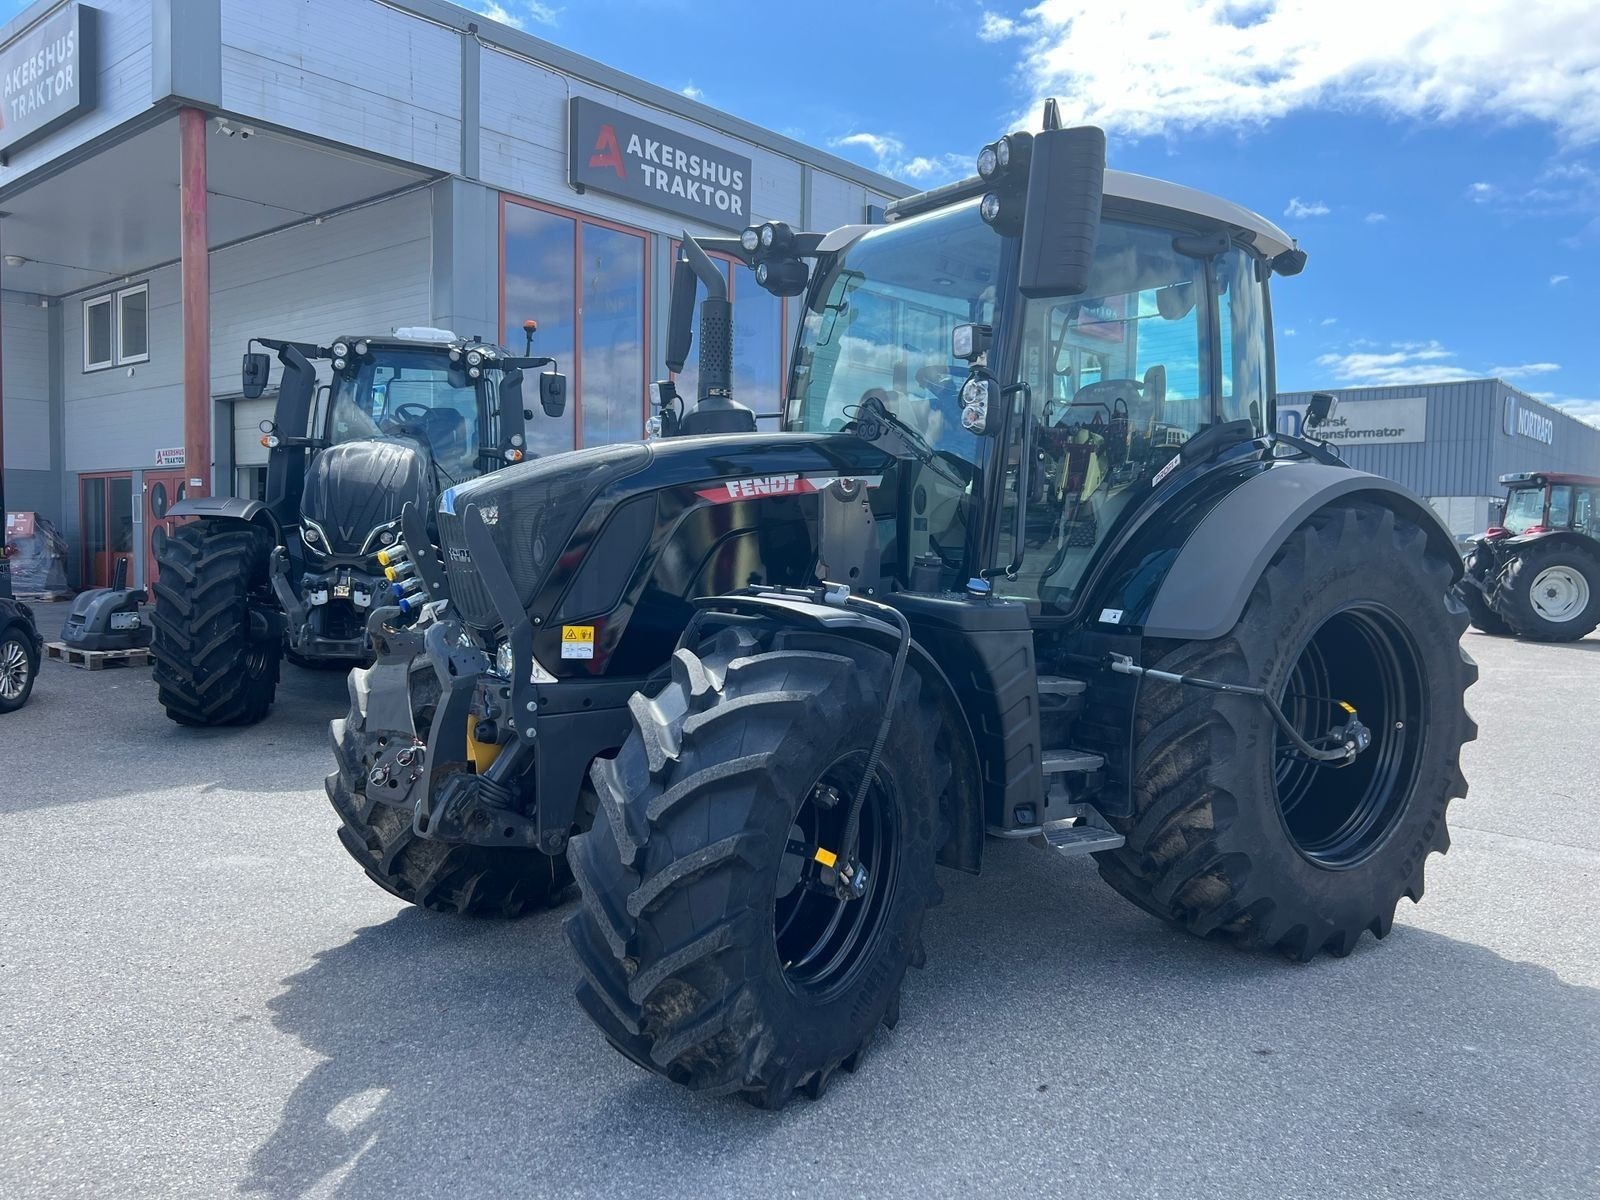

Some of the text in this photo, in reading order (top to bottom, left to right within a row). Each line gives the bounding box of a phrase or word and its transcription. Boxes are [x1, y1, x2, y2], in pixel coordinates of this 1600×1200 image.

[4, 30, 74, 98] AKERSHUS
[11, 64, 74, 121] TRAKTOR
[626, 133, 743, 191] AKERSHUS
[641, 163, 743, 216] TRAKTOR
[1307, 426, 1405, 441] Transformator
[1308, 415, 1348, 429] orsk
[1517, 406, 1553, 446] NORTRAFO
[725, 474, 799, 498] FENDT
